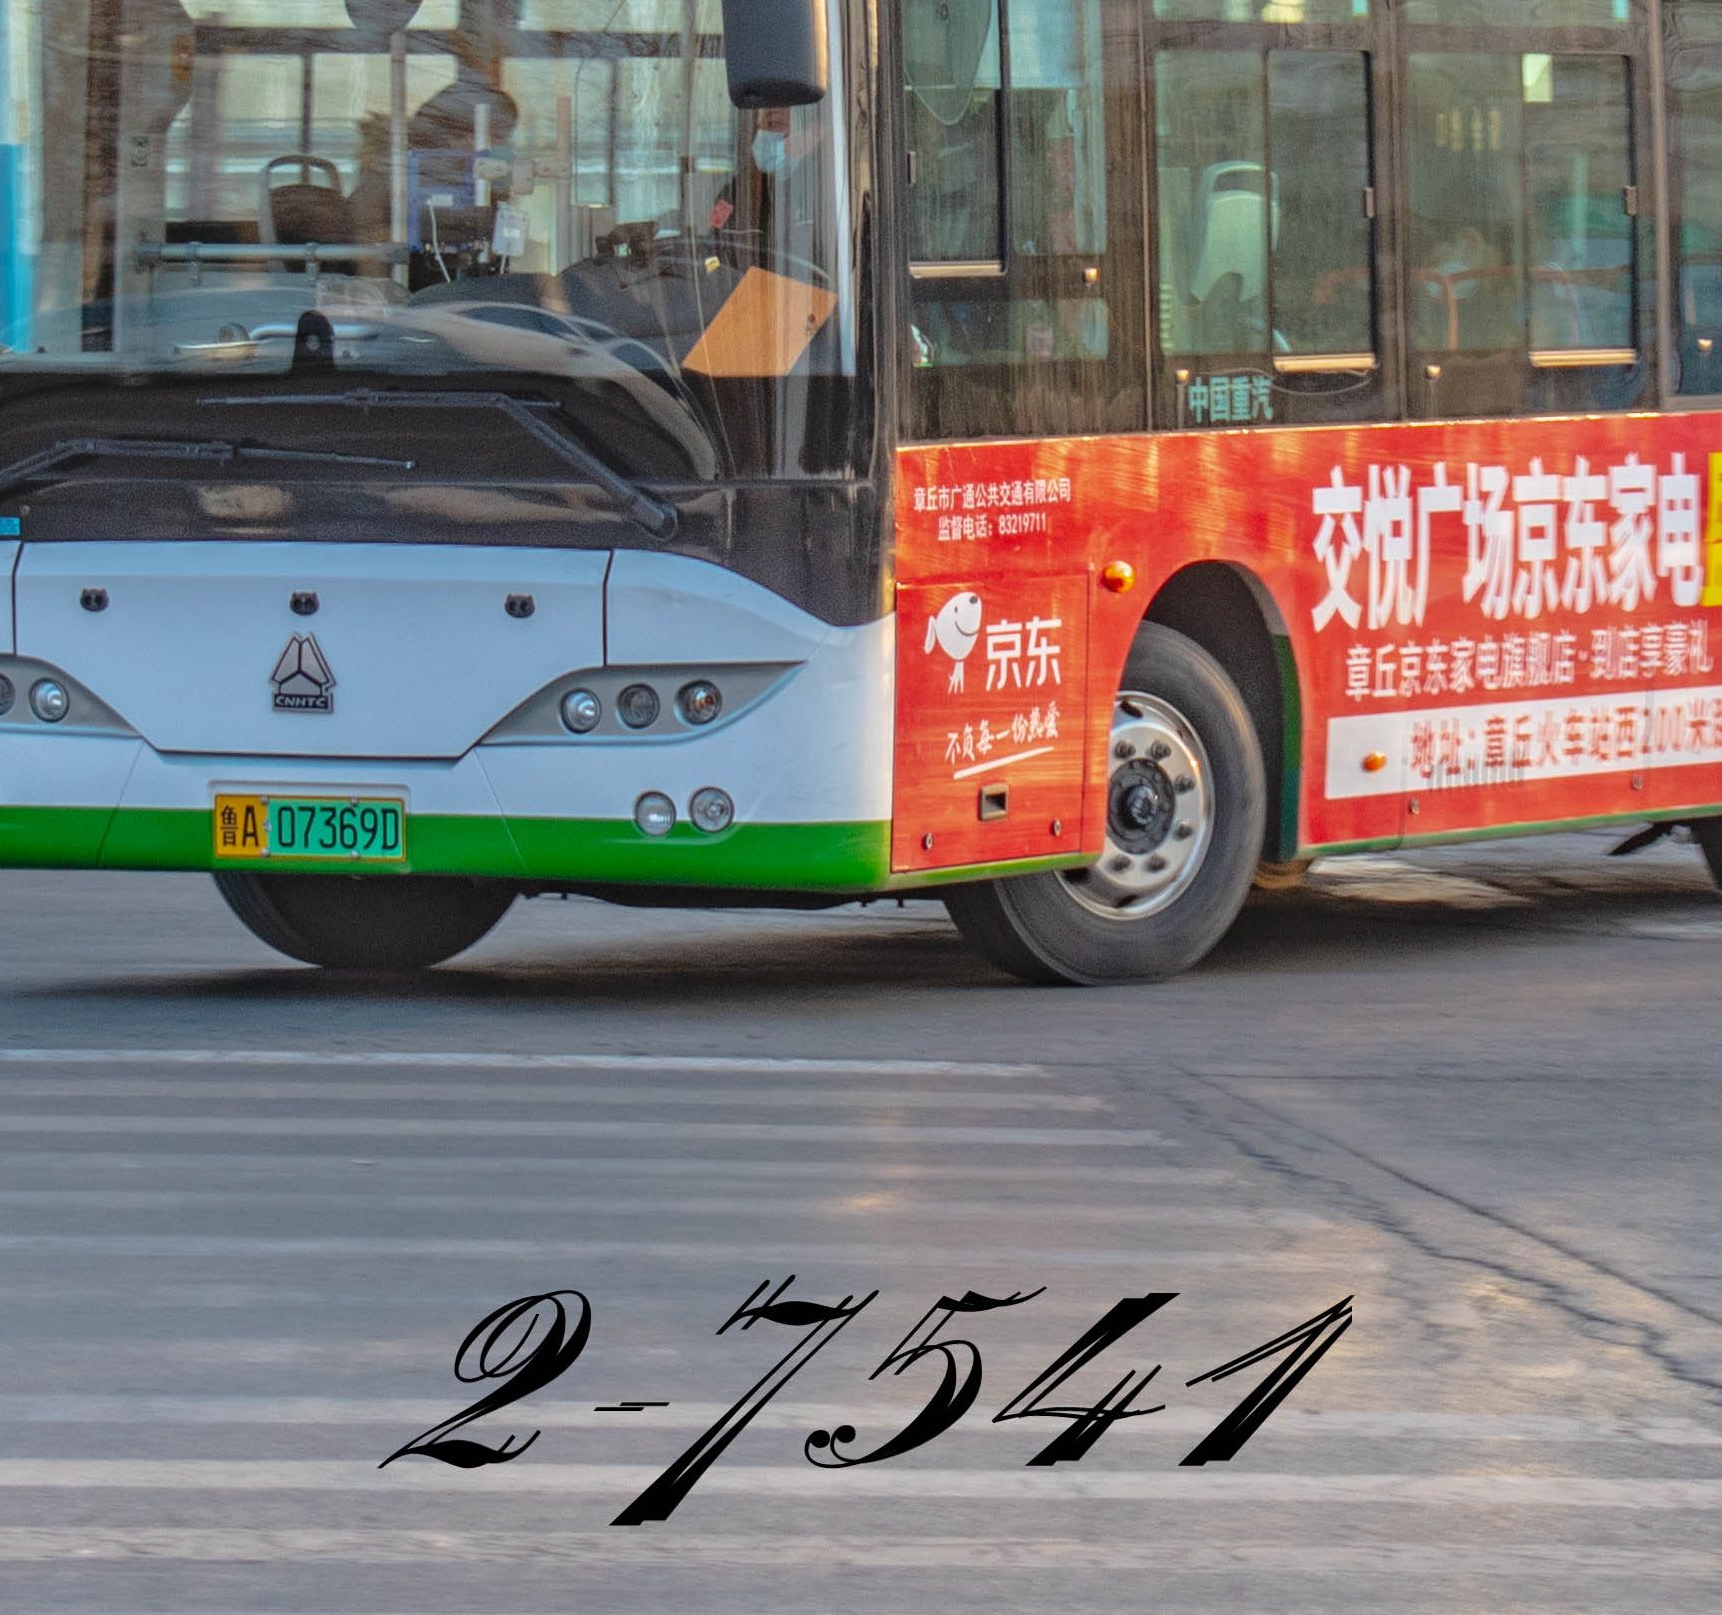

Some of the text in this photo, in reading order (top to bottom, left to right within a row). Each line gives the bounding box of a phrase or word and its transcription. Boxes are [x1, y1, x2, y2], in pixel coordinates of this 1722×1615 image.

[1187, 375, 1273, 424] 中国重汽
[914, 477, 1072, 512] 章丘市广通公共交通有限公司
[1311, 451, 1704, 632] 交悦广场京东家电
[985, 616, 1062, 691] 京东
[276, 695, 326, 707] CNHTC
[944, 700, 1060, 765] 不负每一份热爱
